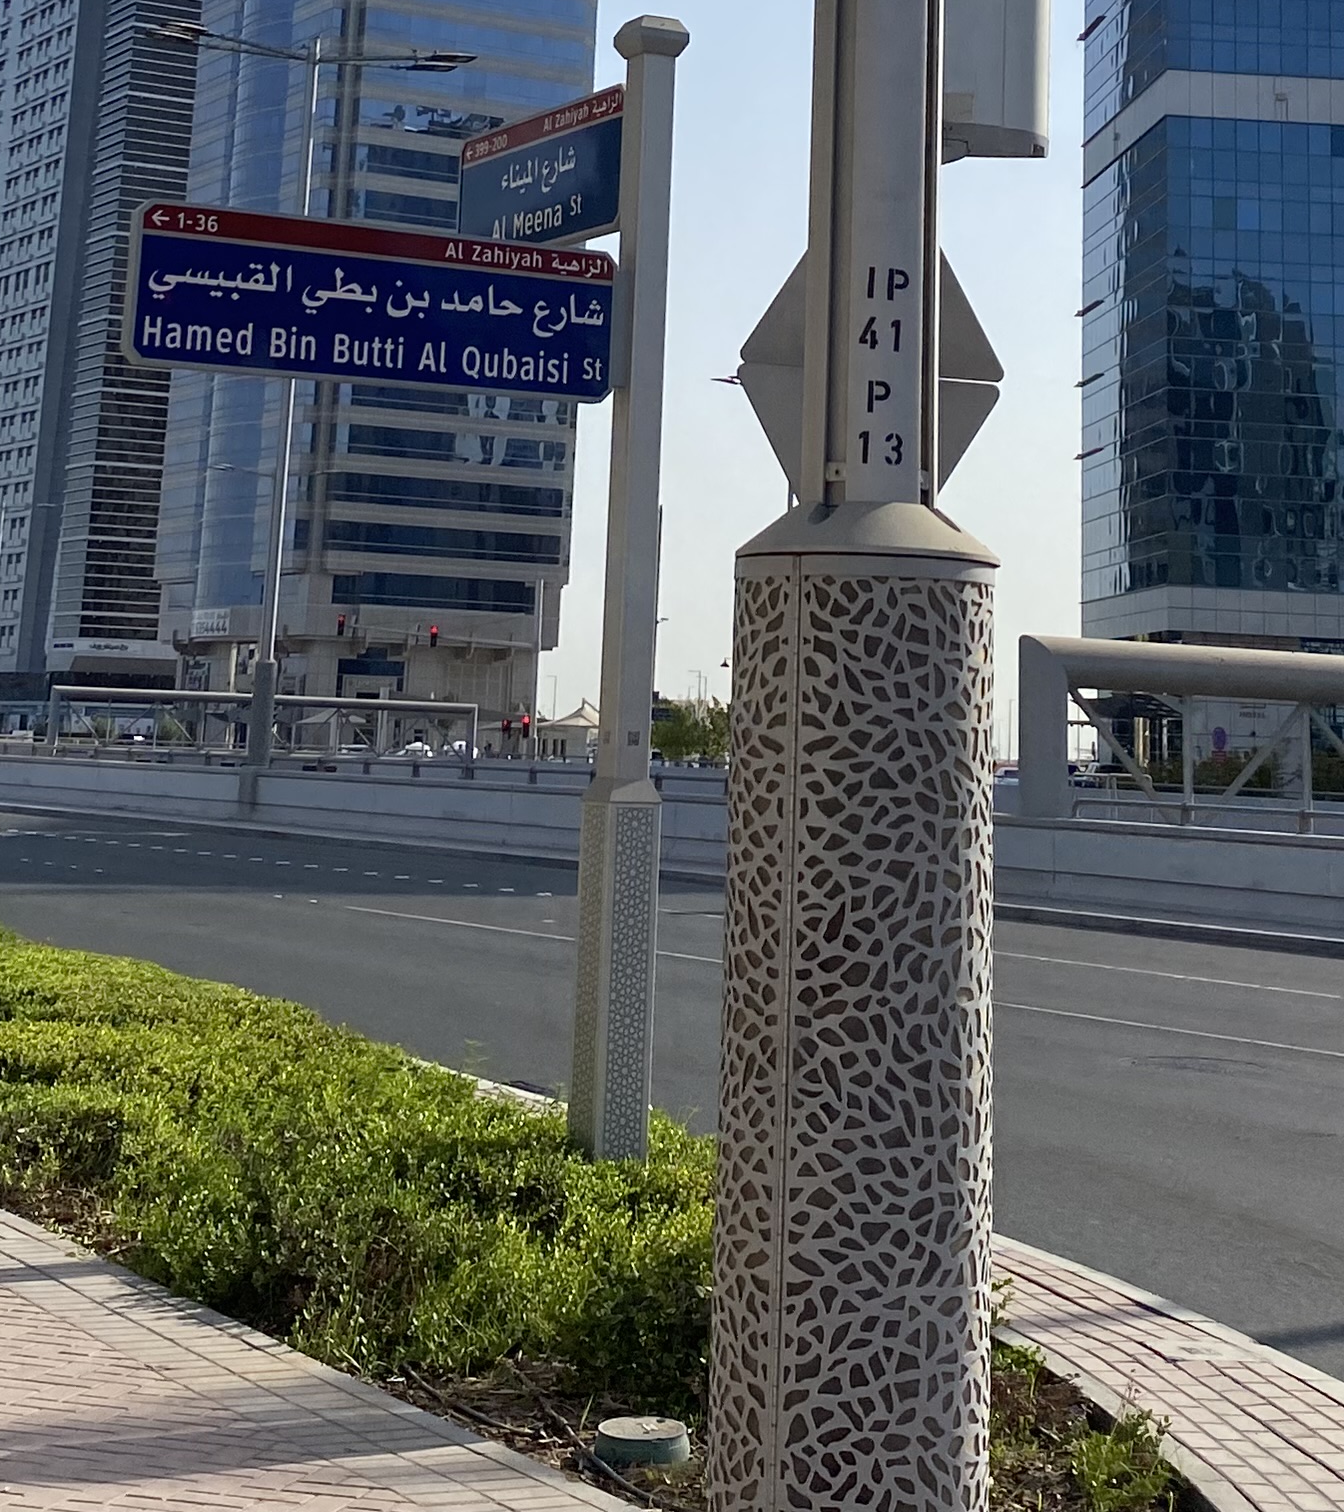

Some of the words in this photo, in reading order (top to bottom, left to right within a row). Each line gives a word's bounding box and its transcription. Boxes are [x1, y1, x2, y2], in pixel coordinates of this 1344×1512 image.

[543, 118, 552, 132] Al
[555, 103, 588, 128] Zahiyah
[592, 92, 622, 117] الزاهية
[474, 133, 508, 158] 399-200
[501, 157, 538, 194] الميناء
[541, 145, 576, 194] شارع
[177, 212, 219, 233] 1-36
[492, 216, 506, 240] Al
[513, 204, 563, 239] Meena
[570, 193, 582, 216] St
[445, 242, 463, 259] Al
[472, 245, 543, 270] Zahiyah
[551, 253, 609, 278] الزاهية
[148, 261, 293, 300] القبيسي
[301, 267, 378, 314] بطي
[866, 266, 910, 301] IP
[386, 280, 430, 320] بن
[441, 284, 524, 316] حامد
[532, 293, 605, 338] شارع
[142, 315, 254, 355] Hamed
[269, 326, 316, 361] Bin
[333, 333, 405, 369] Butti
[418, 341, 447, 373] Al
[462, 346, 568, 384] Qubaisi
[582, 357, 603, 381] St
[858, 316, 901, 352] 41
[866, 380, 891, 413] P
[858, 430, 904, 466] 13
